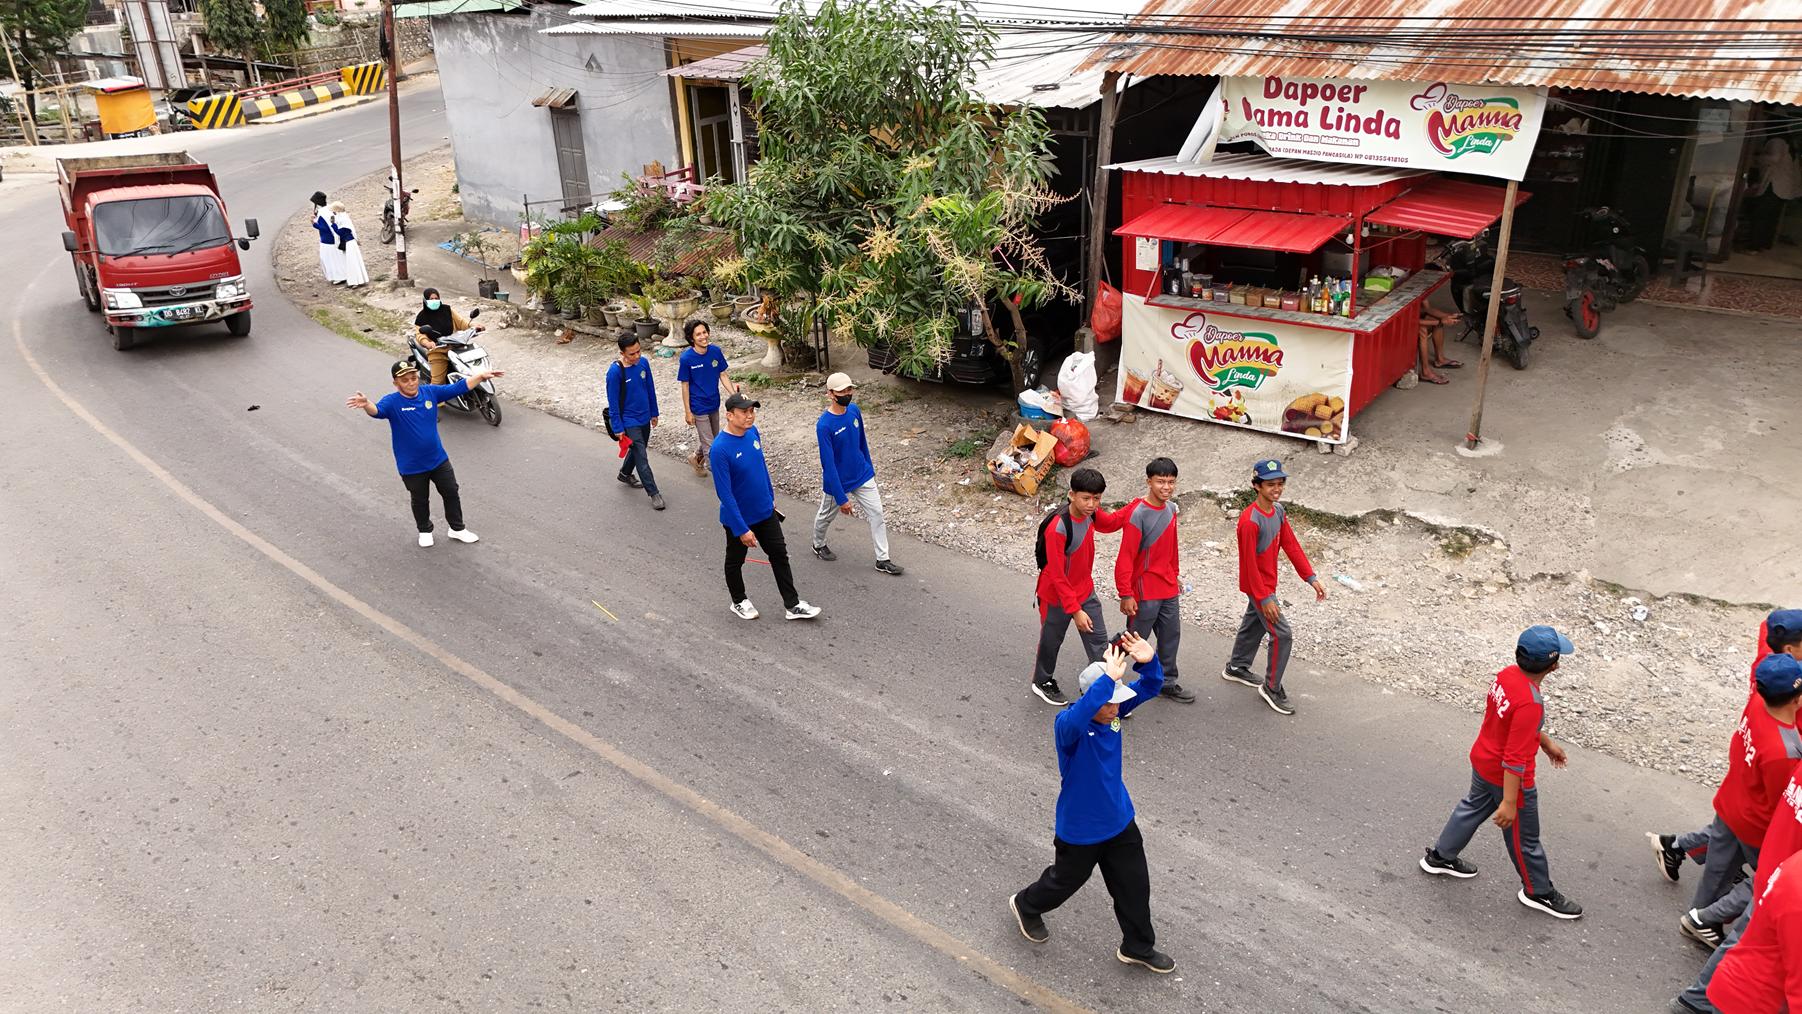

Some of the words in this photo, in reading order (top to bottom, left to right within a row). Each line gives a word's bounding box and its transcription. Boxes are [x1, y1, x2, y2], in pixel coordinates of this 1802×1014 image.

[1263, 75, 1367, 106] Dapoer
[1443, 94, 1487, 113] Dapoer
[1320, 105, 1401, 140] Linda
[1457, 134, 1493, 153] Linda
[1204, 325, 1245, 344] Dapoer
[1222, 368, 1257, 385] Linda
